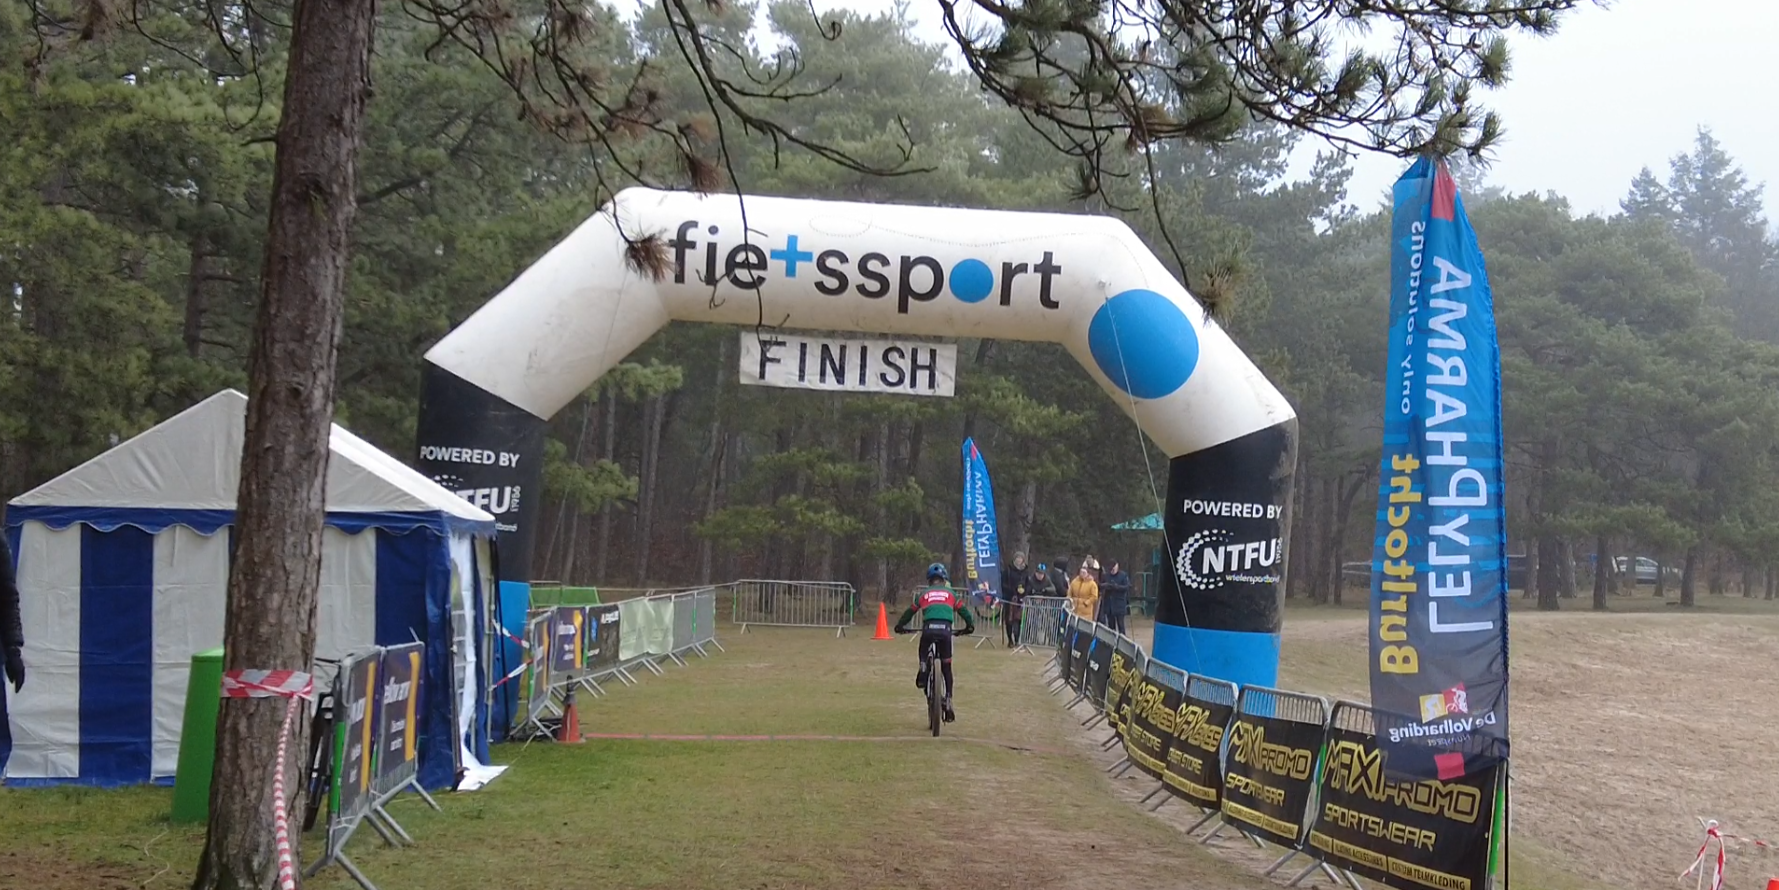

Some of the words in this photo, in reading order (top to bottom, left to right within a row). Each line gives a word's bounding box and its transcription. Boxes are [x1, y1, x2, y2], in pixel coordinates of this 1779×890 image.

[757, 339, 938, 390] FINISH
[420, 446, 496, 465] POWERED
[498, 452, 520, 468] BY
[452, 486, 512, 514] TFU
[1183, 500, 1264, 518] POWERED
[1266, 505, 1283, 519] BY
[1202, 538, 1276, 574] NTFU
[1226, 719, 1313, 780] MAXIPROMO
[1323, 802, 1437, 852] SPORTSWEAR
